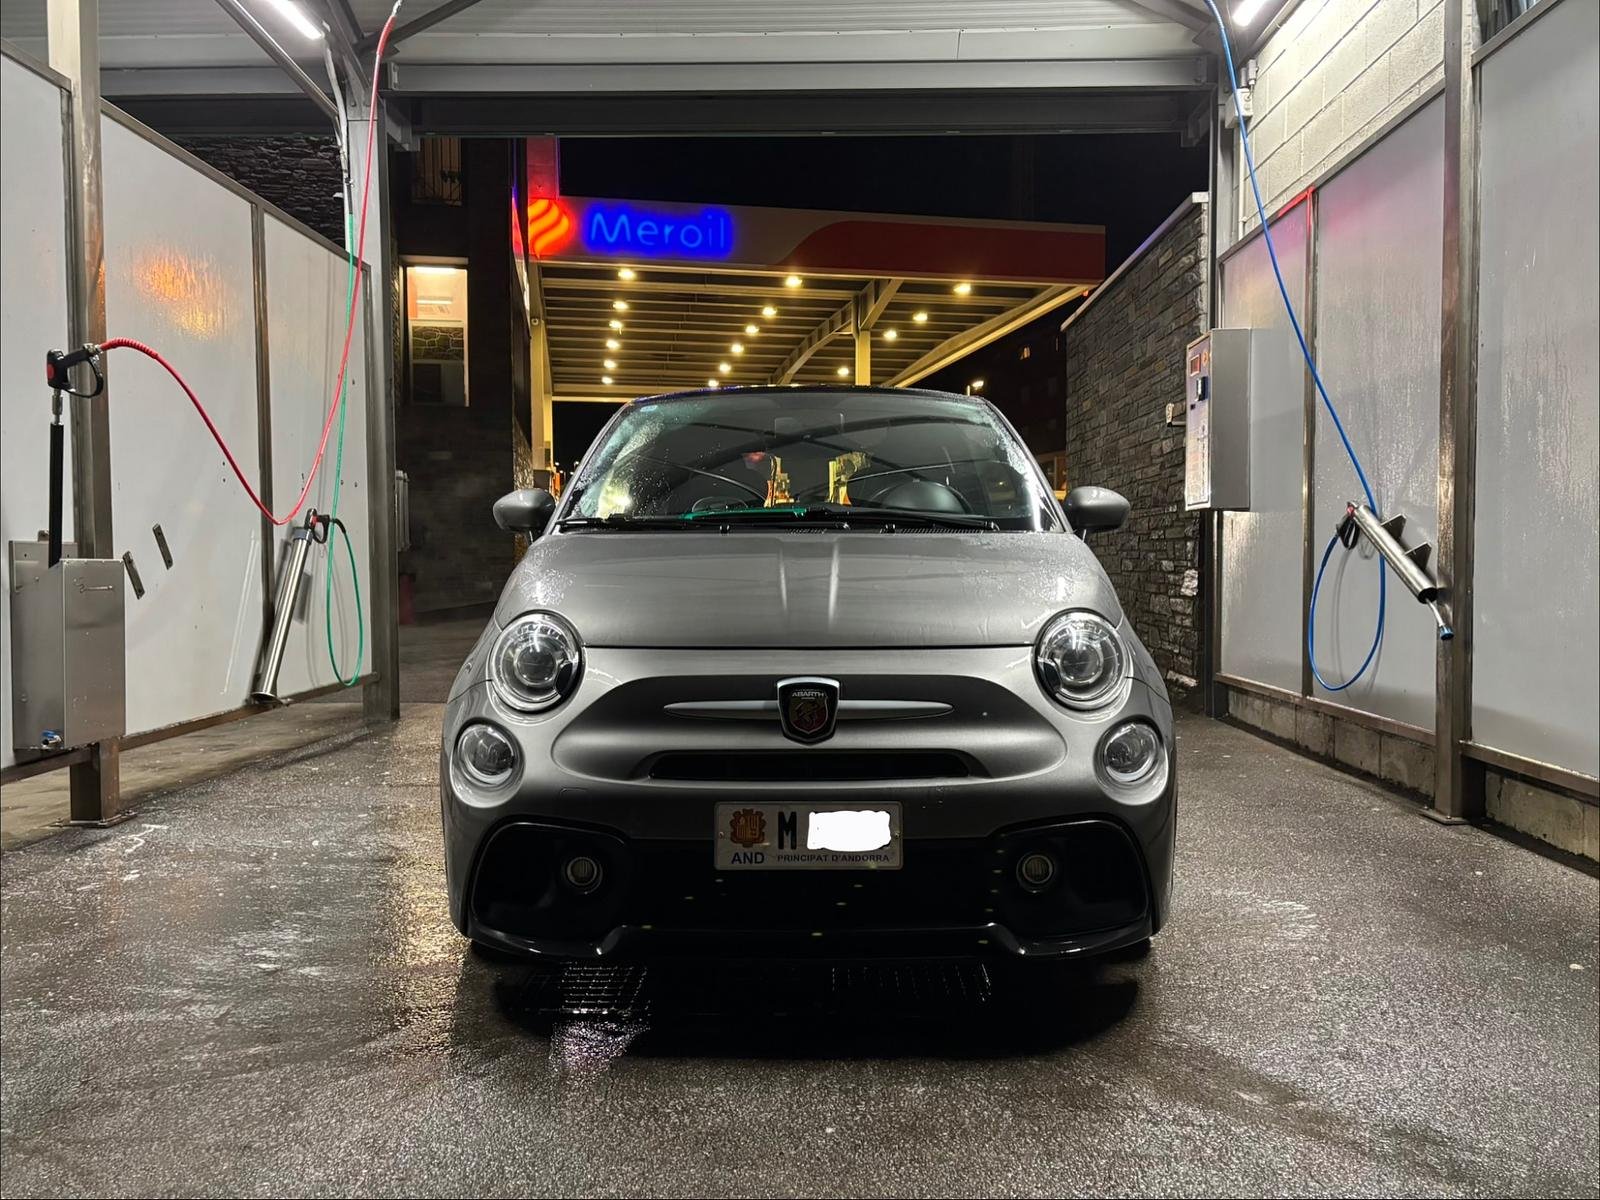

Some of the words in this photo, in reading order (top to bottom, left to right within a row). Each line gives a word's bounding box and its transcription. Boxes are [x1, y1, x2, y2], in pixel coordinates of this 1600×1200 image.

[588, 210, 728, 251] Meroil
[777, 811, 797, 850] M
[731, 852, 765, 865] AND
[777, 854, 829, 863] PRINCIPAT
[831, 854, 889, 863] D'ANDORRA
